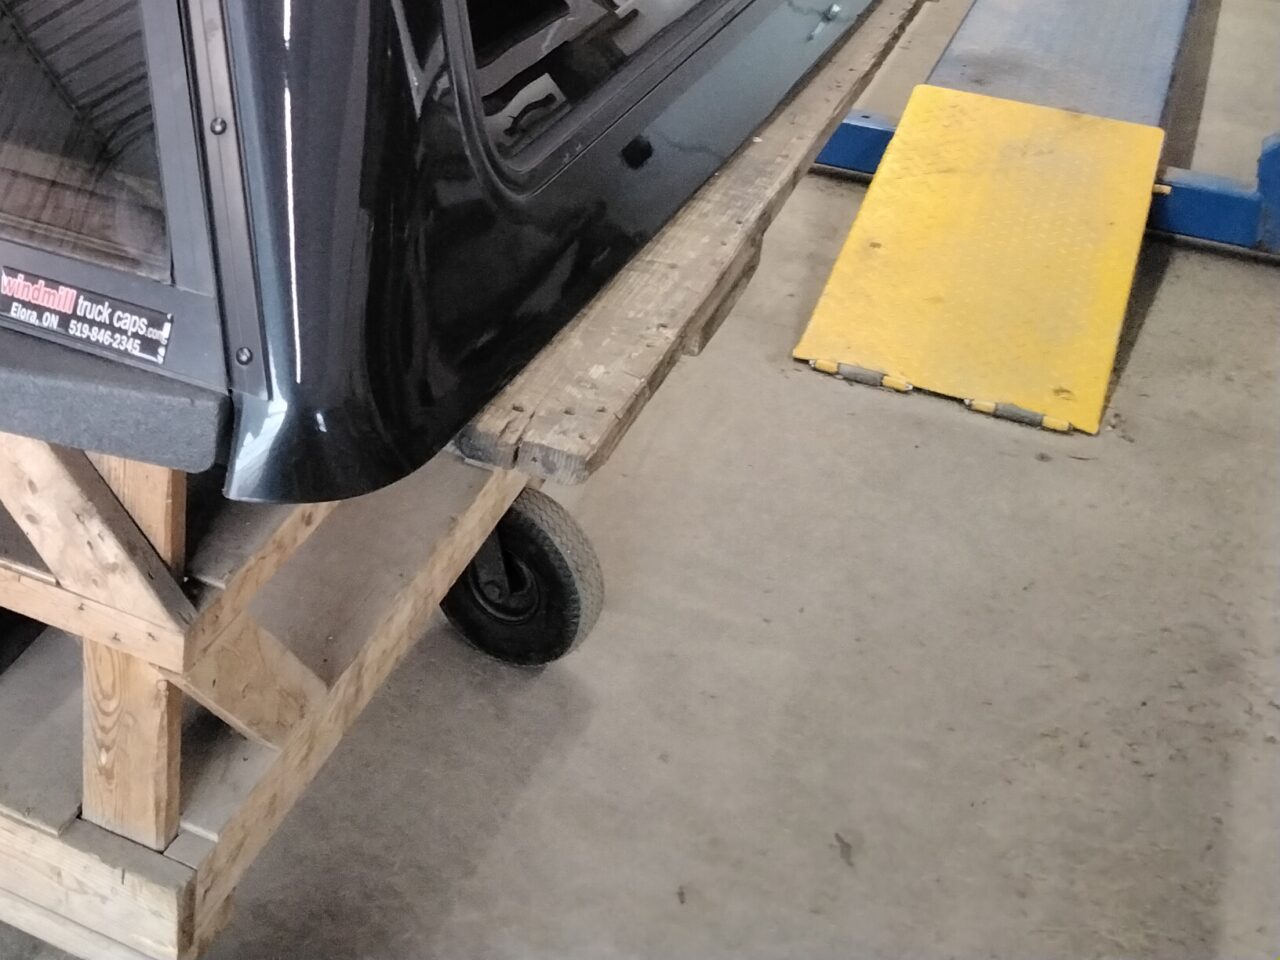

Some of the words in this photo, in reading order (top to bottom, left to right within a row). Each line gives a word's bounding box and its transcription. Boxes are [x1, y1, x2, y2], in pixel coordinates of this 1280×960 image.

[0, 273, 78, 315] windmill
[76, 295, 113, 325] truck
[10, 302, 39, 326] Elora,
[42, 312, 60, 329] ON
[68, 319, 142, 354] 519-846-2345
